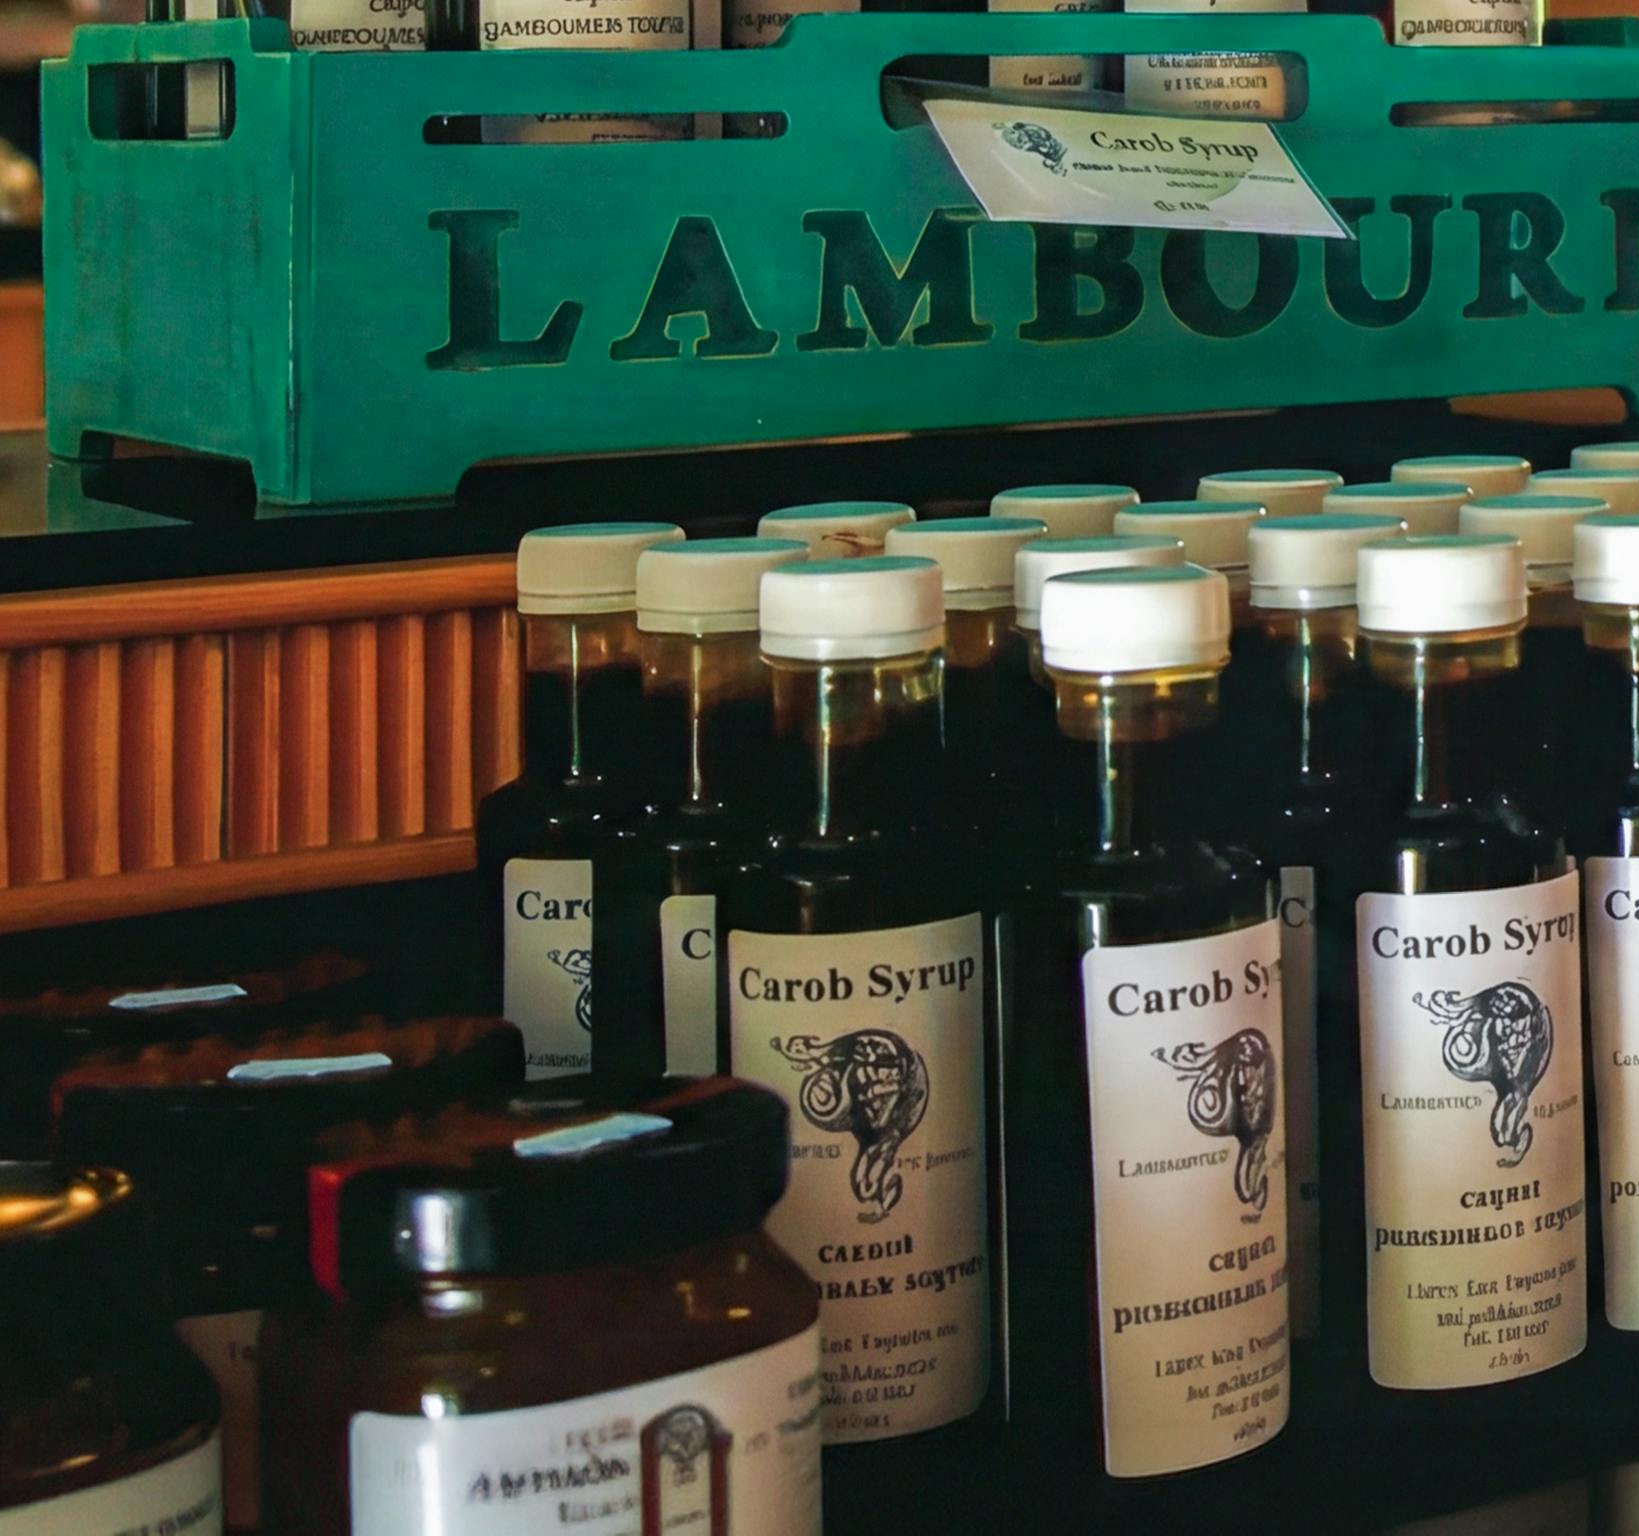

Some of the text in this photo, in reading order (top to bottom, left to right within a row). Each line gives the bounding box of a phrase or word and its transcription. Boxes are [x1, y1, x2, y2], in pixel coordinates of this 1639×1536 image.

[1090, 130, 1259, 163] Carob Syrup
[1372, 923, 1492, 960] Carob
[738, 954, 976, 1005] Carob Syrup
[1107, 969, 1234, 1019] Carob
